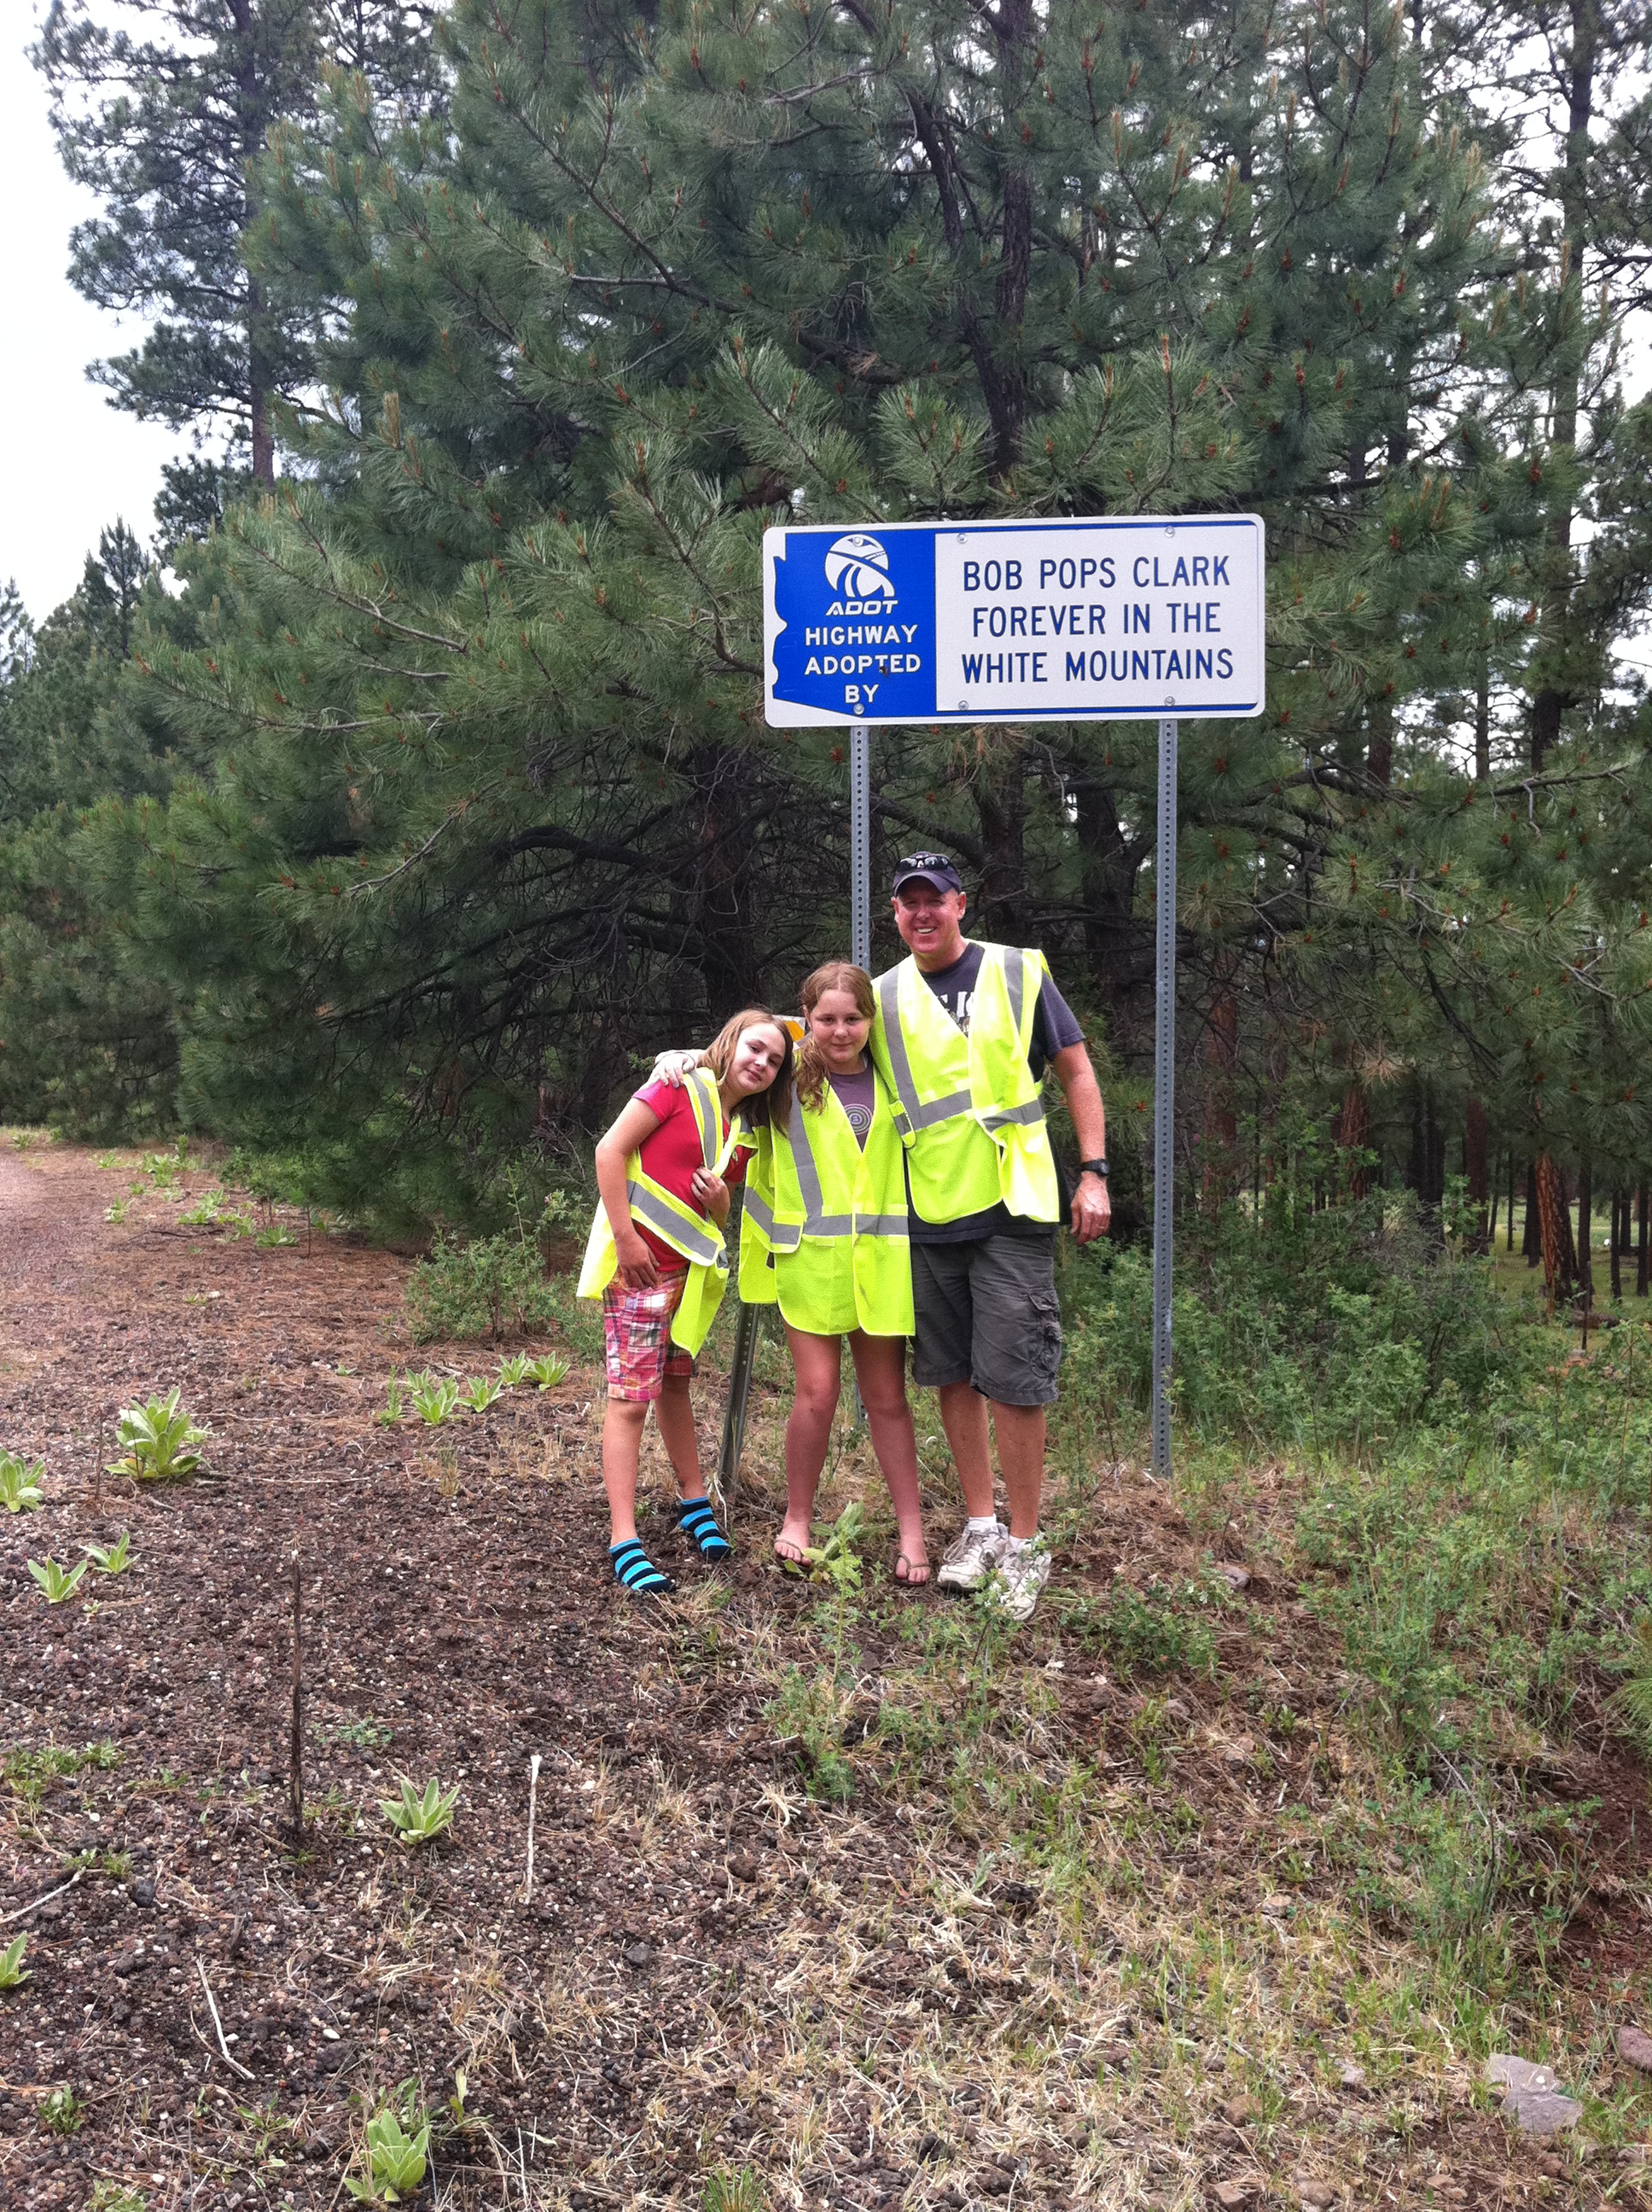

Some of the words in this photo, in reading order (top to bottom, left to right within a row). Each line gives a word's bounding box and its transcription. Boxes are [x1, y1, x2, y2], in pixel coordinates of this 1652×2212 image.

[963, 559, 1023, 591] BOB
[1039, 557, 1116, 589] POPS
[1132, 555, 1230, 587] CLARK
[826, 600, 898, 615] ADOT
[972, 604, 1106, 637] FOREVER
[1123, 604, 1150, 634] IN
[1166, 602, 1221, 633] THE
[805, 625, 917, 646] HIGHWAY
[804, 654, 921, 675] ADOPTED
[961, 652, 1049, 684] WHITE
[1065, 648, 1234, 682] MOUNTAINS
[845, 684, 879, 703] BY
